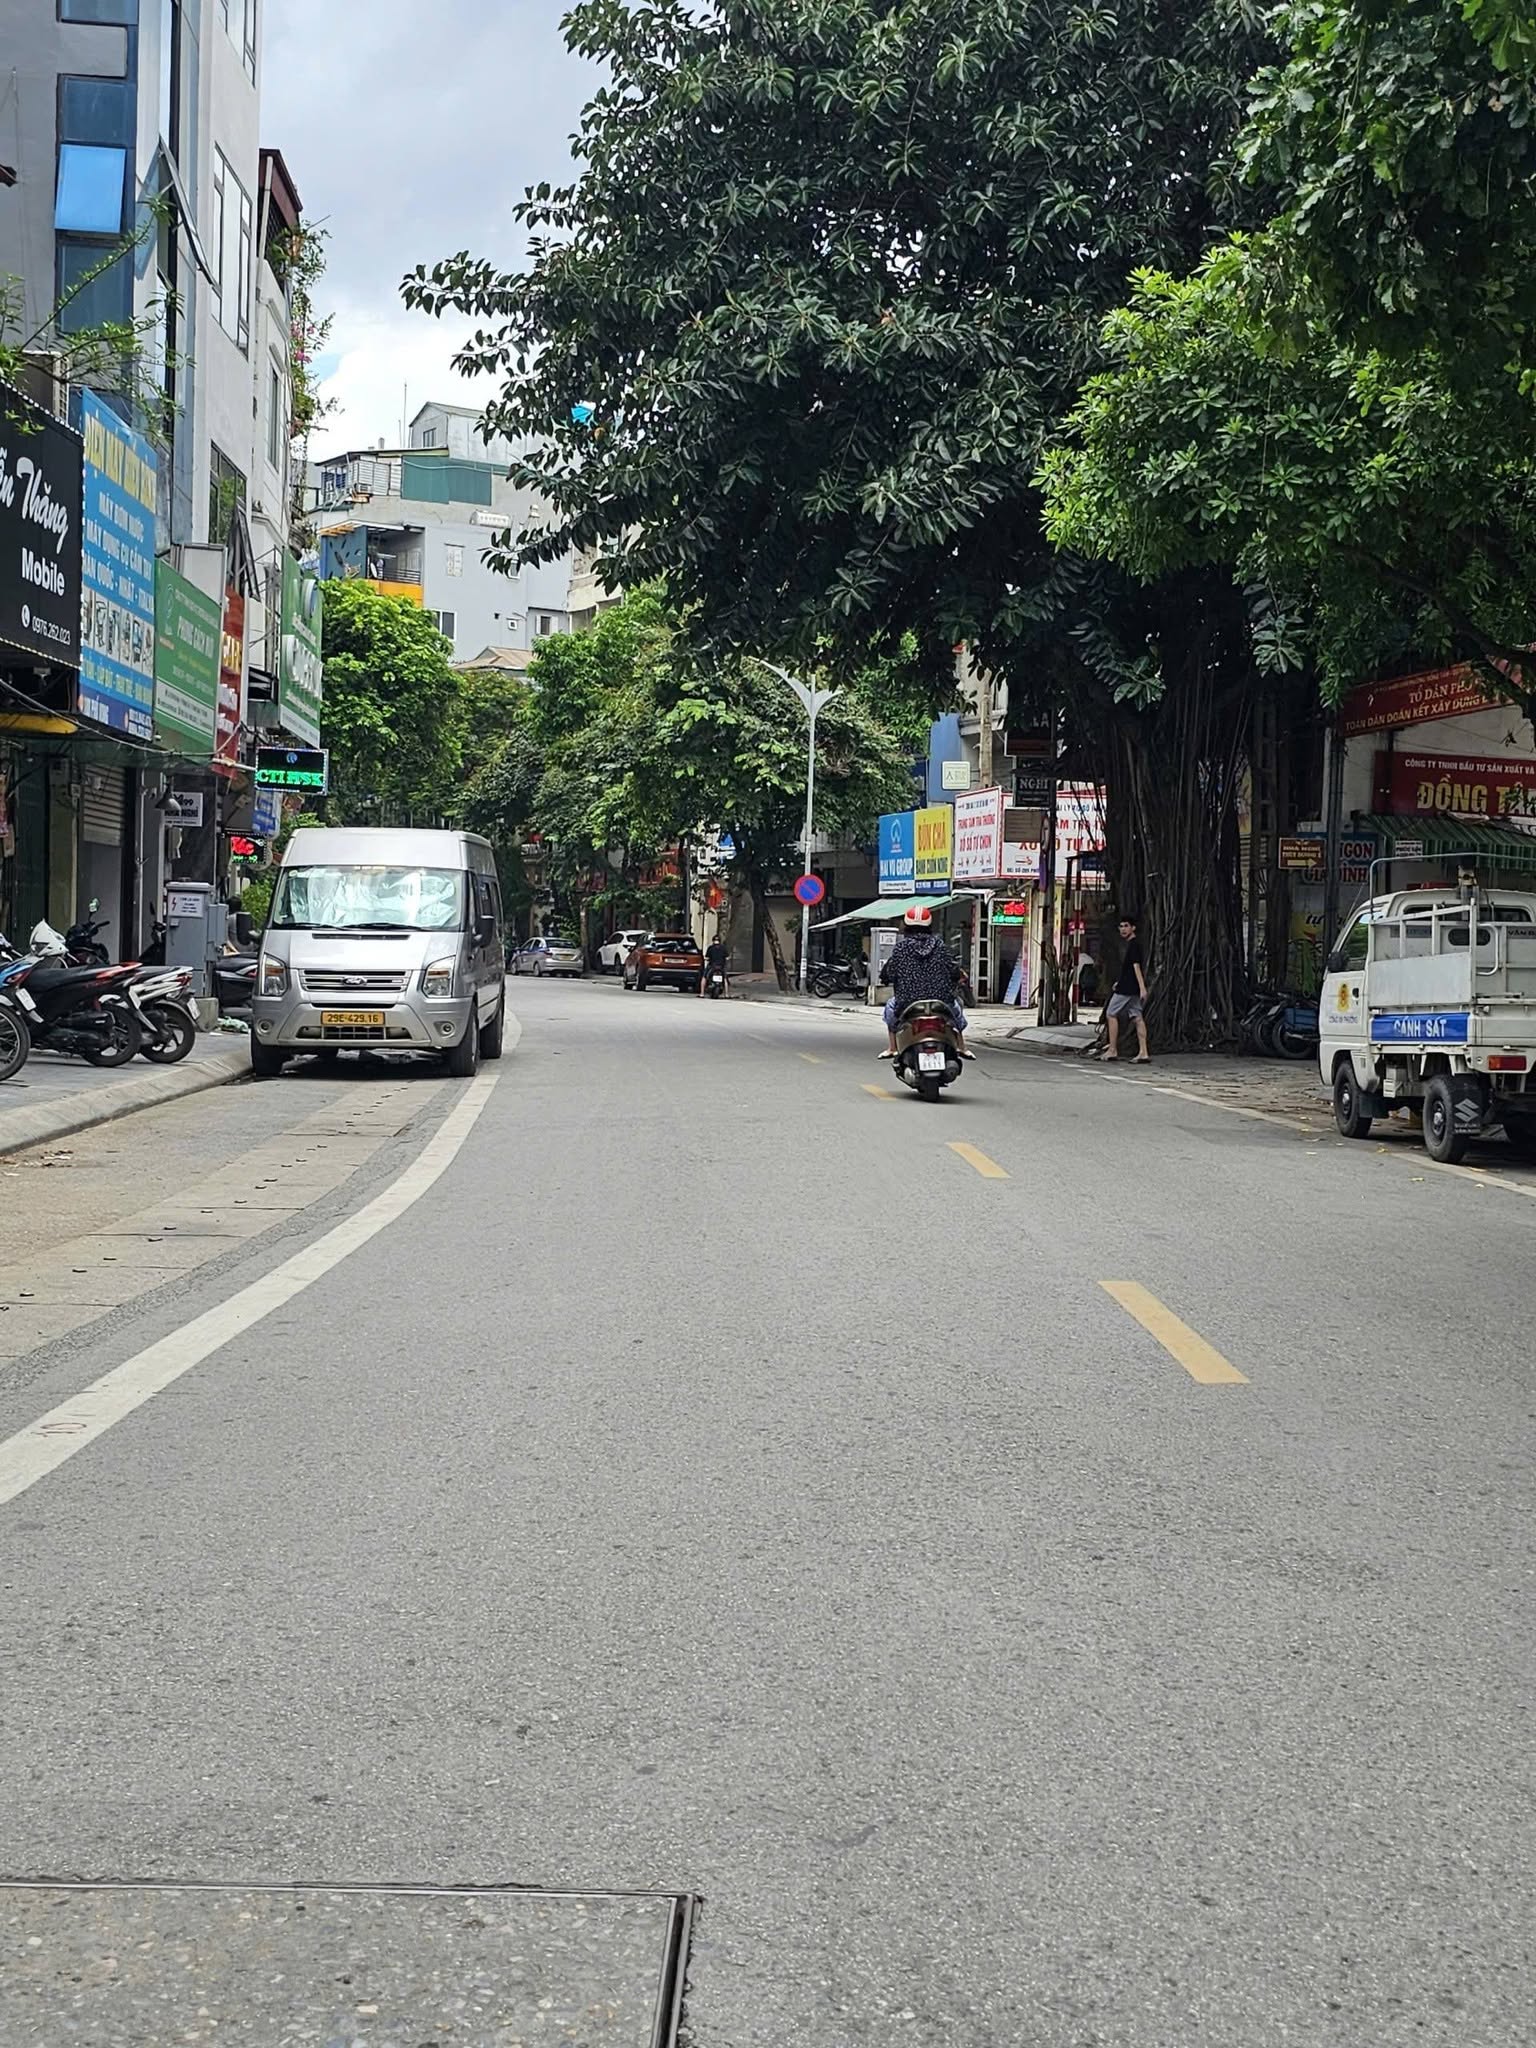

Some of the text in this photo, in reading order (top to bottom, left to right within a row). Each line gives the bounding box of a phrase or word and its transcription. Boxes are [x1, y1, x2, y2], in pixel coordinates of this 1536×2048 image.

[21, 546, 66, 597] Mobile
[1423, 683, 1448, 700] DÂN
[1430, 697, 1452, 715] XÂY
[1405, 758, 1426, 768] CÔNG
[1428, 759, 1437, 769] TY
[257, 769, 285, 784] CTI
[1417, 772, 1488, 811] ĐỒNG
[896, 857, 914, 875] GROUP
[327, 1014, 379, 1023] 29E-429.16
[1426, 1016, 1447, 1037] SÁT
